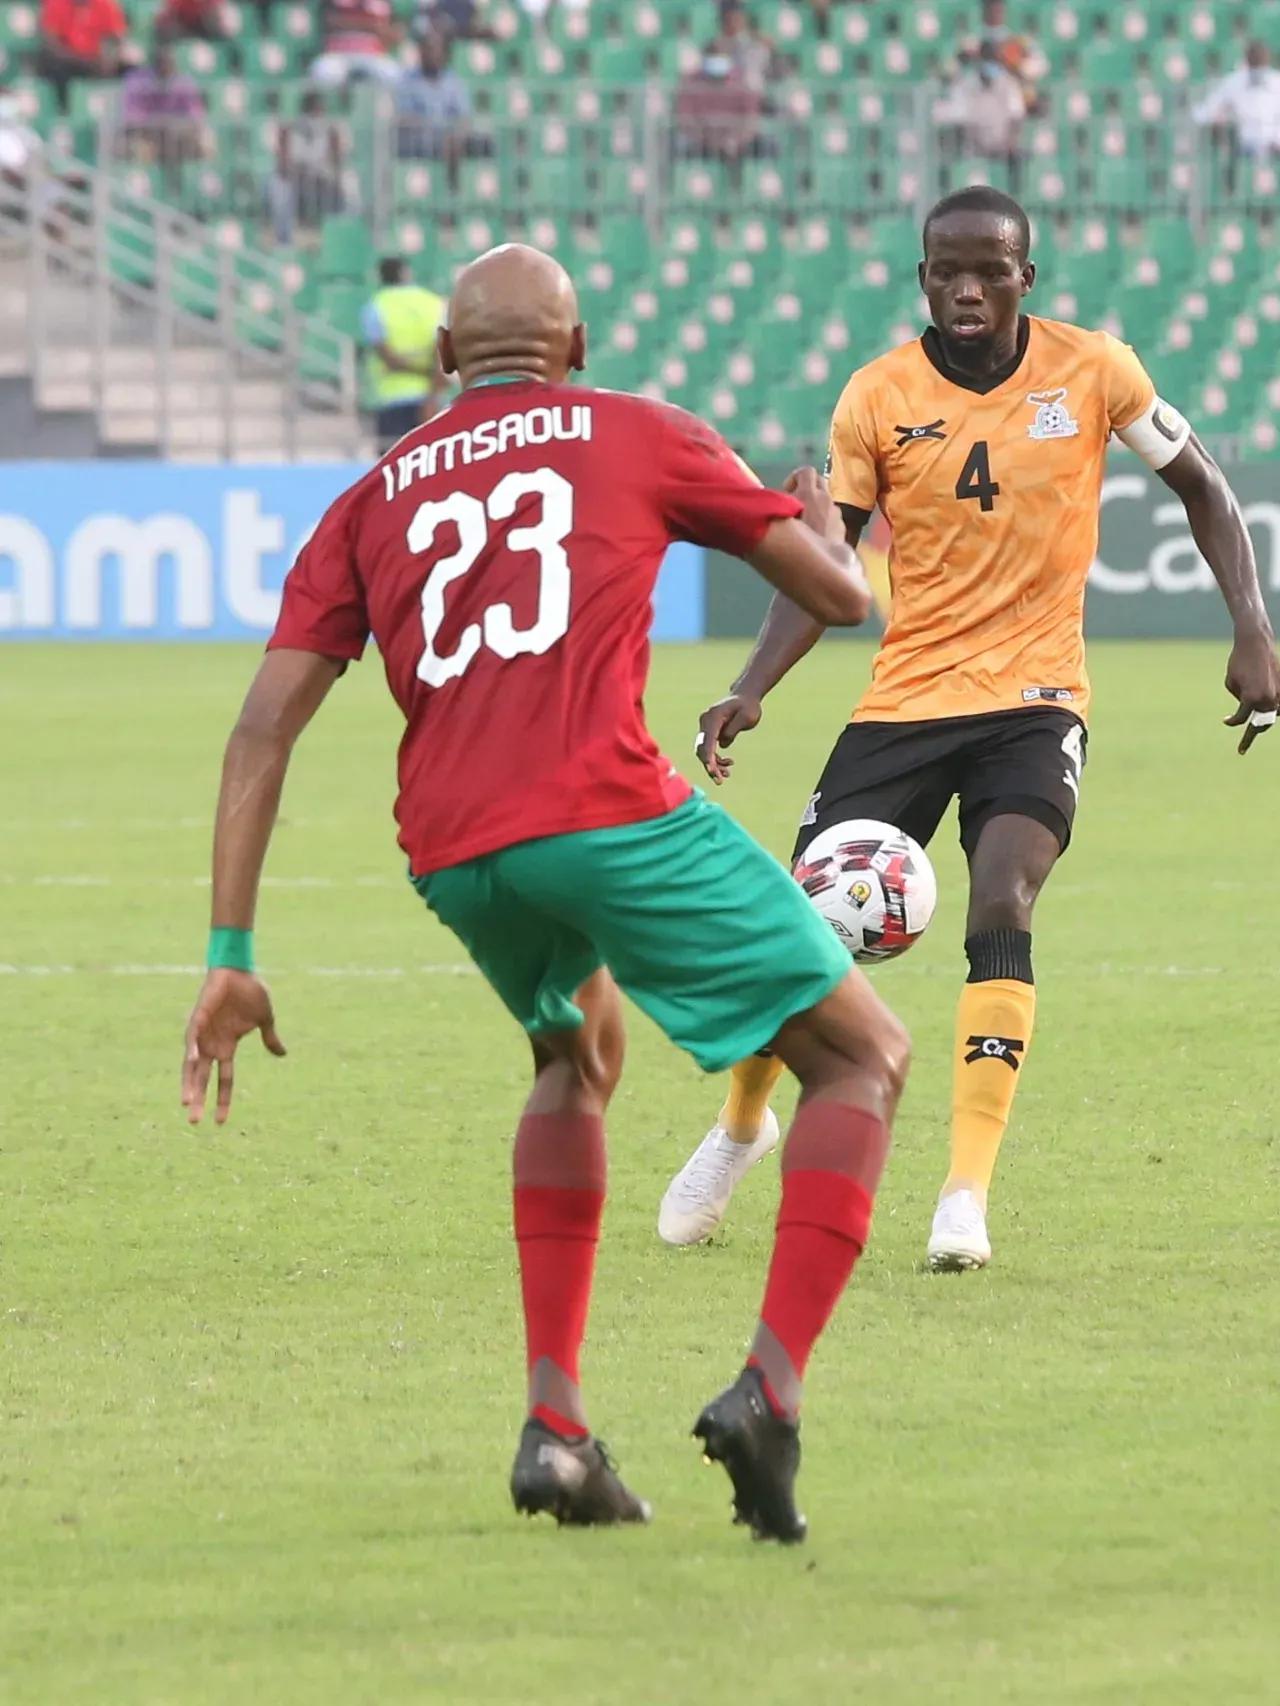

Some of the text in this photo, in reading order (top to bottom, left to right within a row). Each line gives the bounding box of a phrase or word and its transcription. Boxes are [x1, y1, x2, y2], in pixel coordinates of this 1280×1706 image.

[955, 441, 1000, 512] 4
[0, 489, 319, 630] amt
[406, 466, 575, 689] 23
